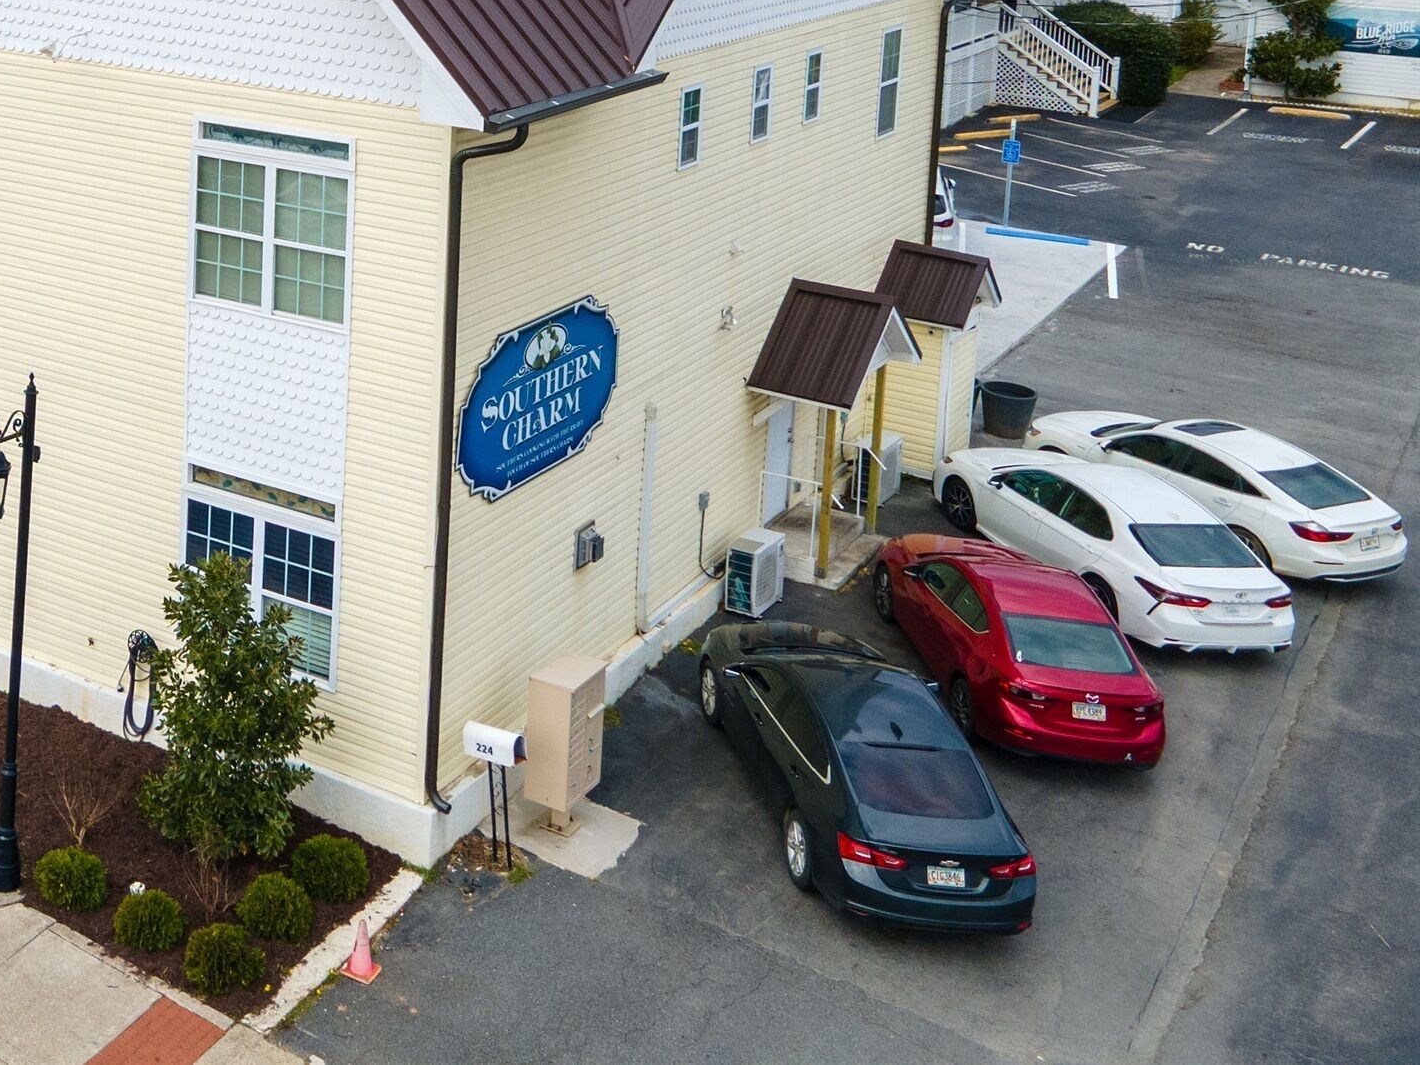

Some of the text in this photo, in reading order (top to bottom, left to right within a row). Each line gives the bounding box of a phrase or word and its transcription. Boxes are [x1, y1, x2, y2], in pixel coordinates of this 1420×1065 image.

[1356, 20, 1416, 40] BLUE RIDGE
[1186, 242, 1225, 253] NO
[1259, 253, 1391, 279] PARKING
[481, 345, 603, 433] SOUTHERN
[502, 387, 582, 451] CHARM
[476, 743, 493, 755] 224
